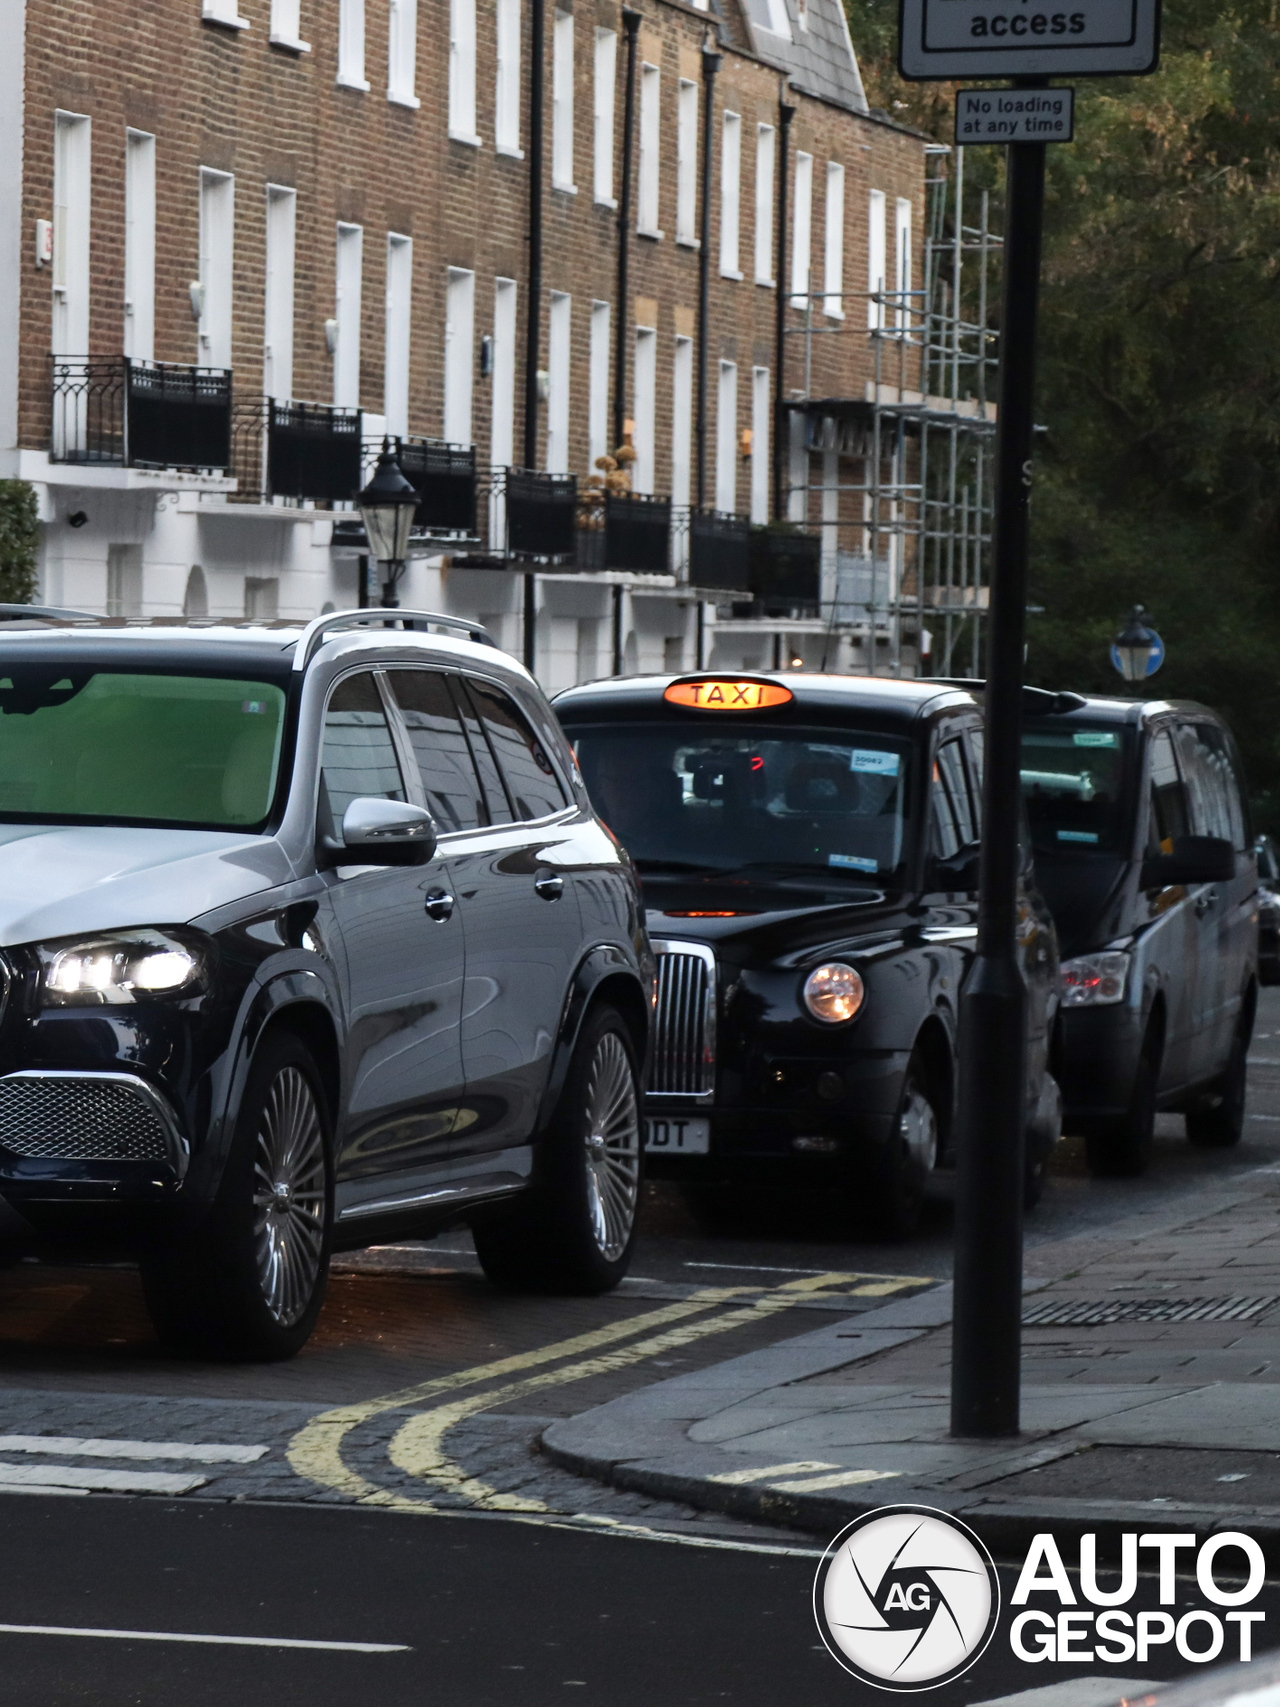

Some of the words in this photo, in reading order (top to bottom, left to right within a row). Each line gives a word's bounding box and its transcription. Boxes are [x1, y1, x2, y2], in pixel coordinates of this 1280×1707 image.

[971, 13, 1086, 37] access
[966, 99, 991, 114] No
[998, 97, 1063, 115] loading
[963, 119, 981, 134] at
[987, 119, 1018, 135] any
[1025, 117, 1064, 132] time
[690, 684, 765, 705] TAXI
